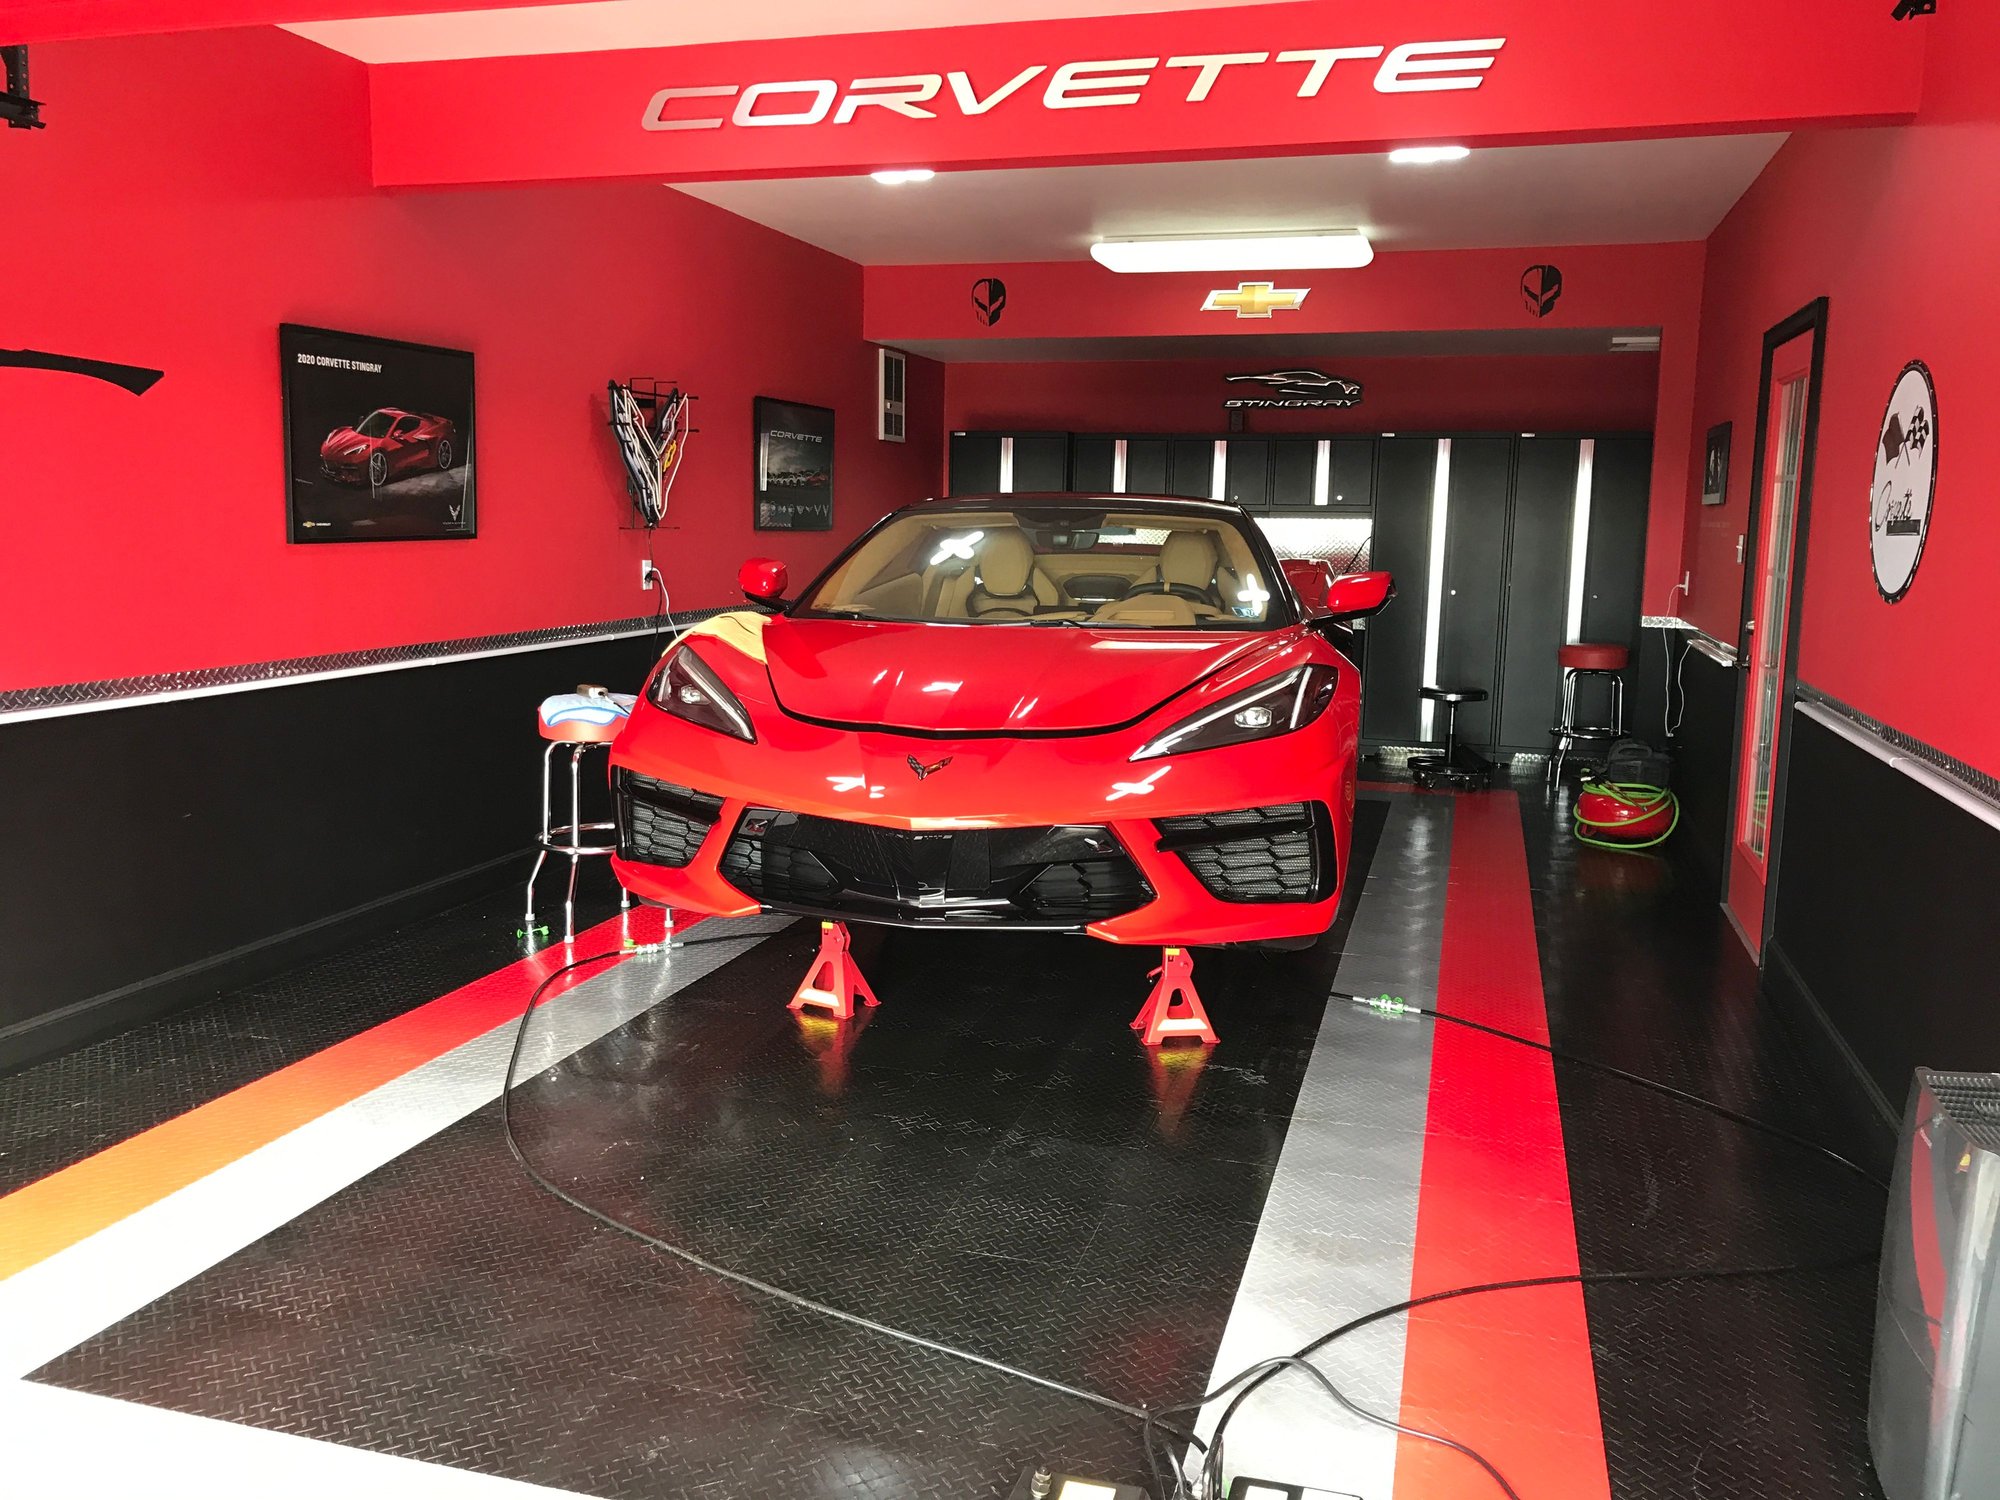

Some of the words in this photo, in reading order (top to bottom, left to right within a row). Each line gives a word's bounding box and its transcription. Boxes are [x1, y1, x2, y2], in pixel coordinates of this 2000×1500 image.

[641, 37, 1507, 132] CORVETTE
[297, 353, 316, 365] 2020
[316, 356, 351, 369] CORVETTE
[351, 361, 382, 373] STINGRAY
[1223, 399, 1361, 408] STINGRAY
[770, 430, 823, 443] CORVETTE
